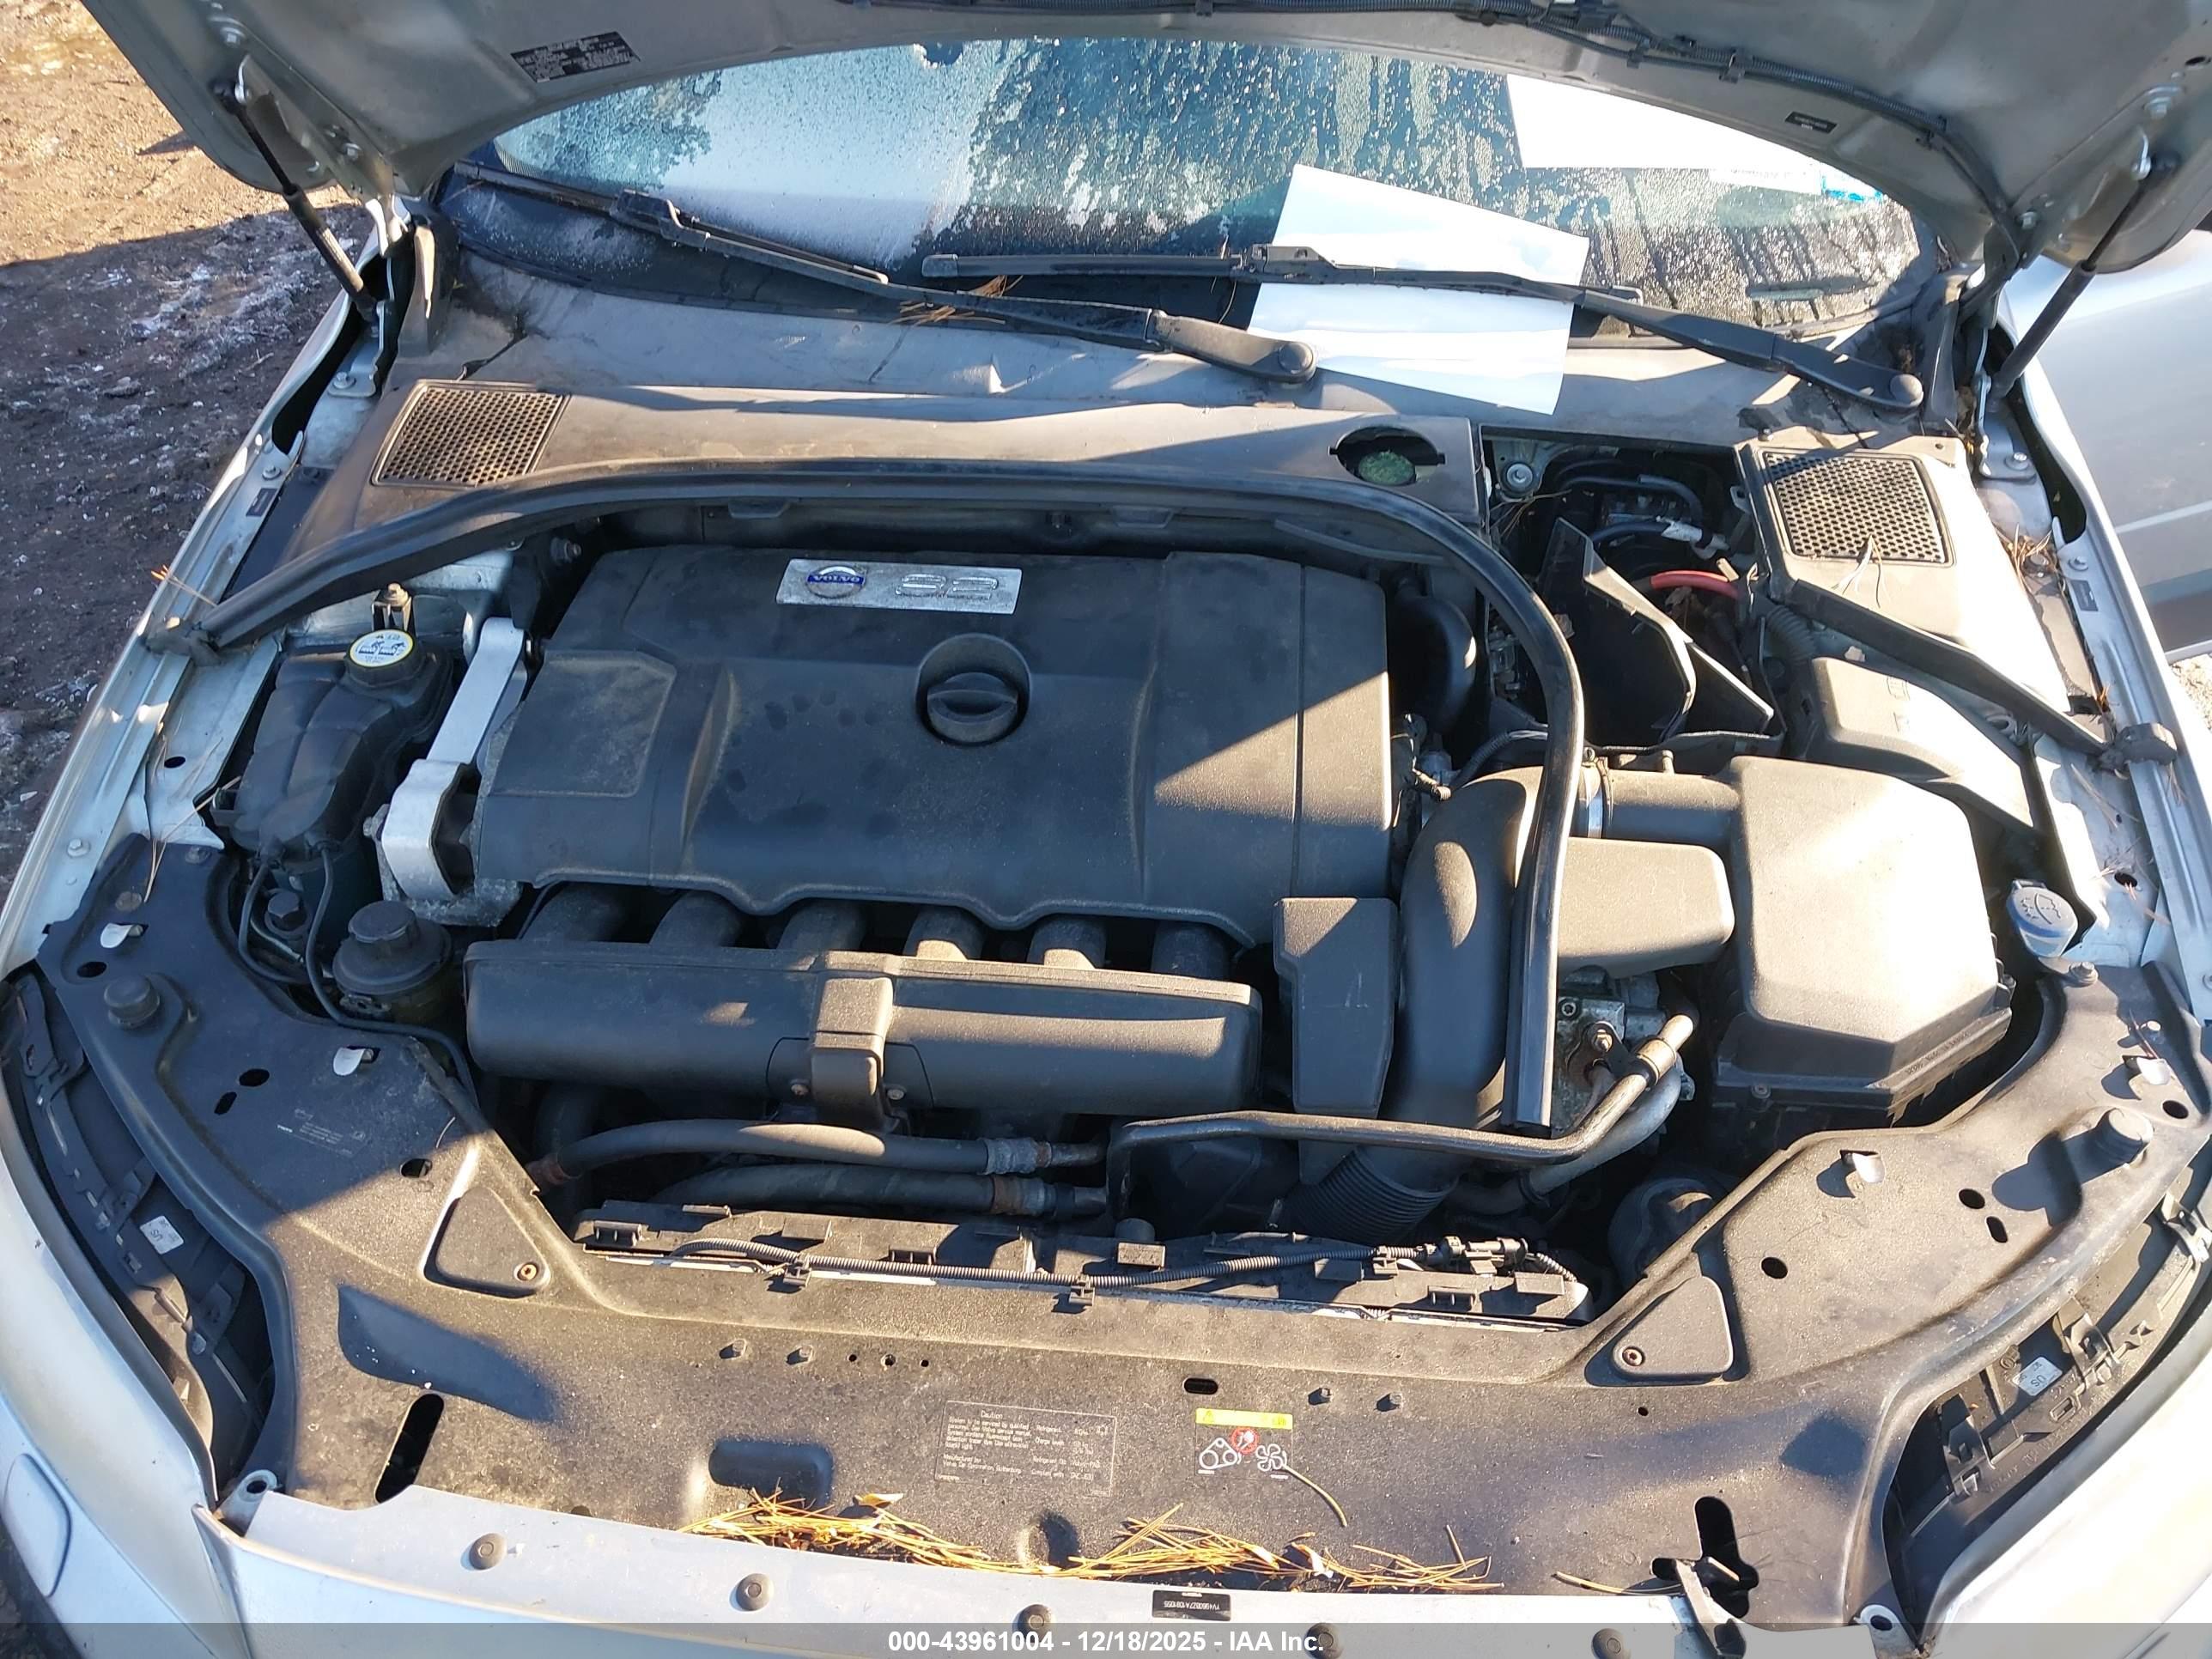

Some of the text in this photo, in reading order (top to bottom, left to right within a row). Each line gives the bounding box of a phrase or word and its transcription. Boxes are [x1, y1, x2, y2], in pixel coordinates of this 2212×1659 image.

[813, 574, 861, 583] VOLVO
[2030, 1374, 2046, 1387] US
[981, 1410, 1003, 1419] Caution
